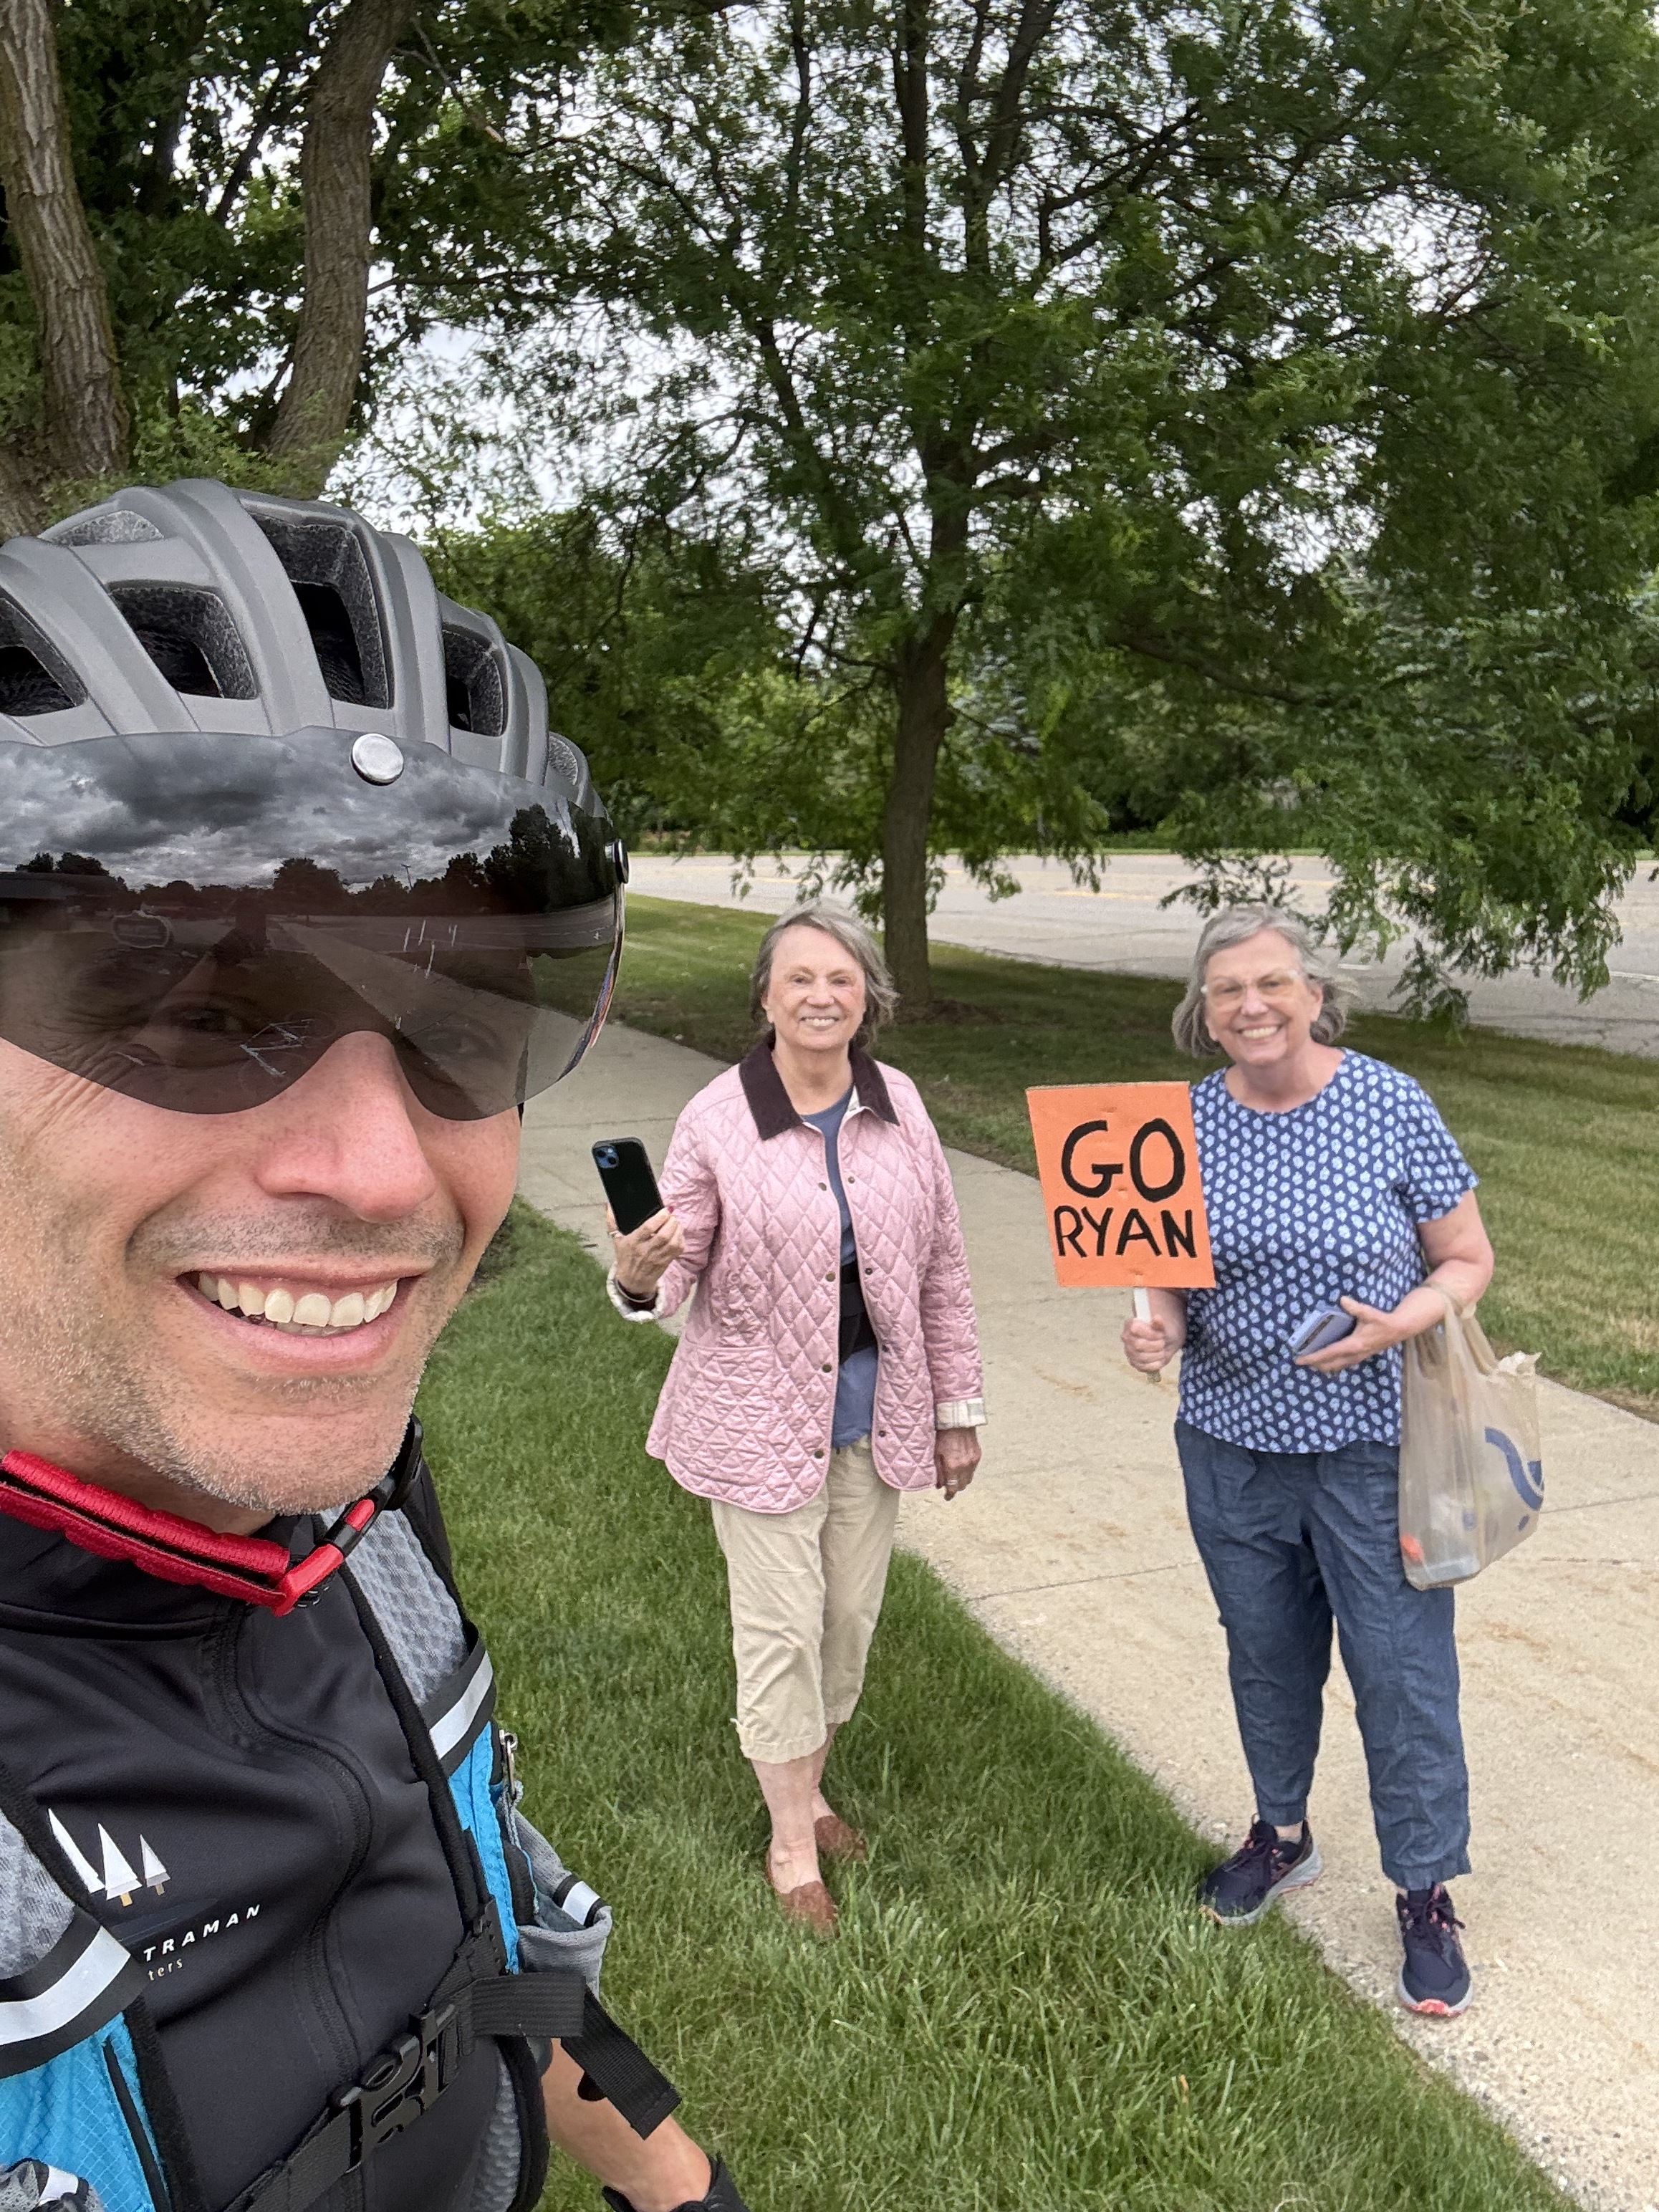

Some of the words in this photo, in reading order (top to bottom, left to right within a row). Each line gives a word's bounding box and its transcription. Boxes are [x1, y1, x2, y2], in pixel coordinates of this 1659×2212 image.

[1061, 1117, 1186, 1203] GO
[1054, 1206, 1198, 1258] RYAN
[143, 1904, 260, 1962] TRAMAN
[148, 1958, 183, 1981] ters
